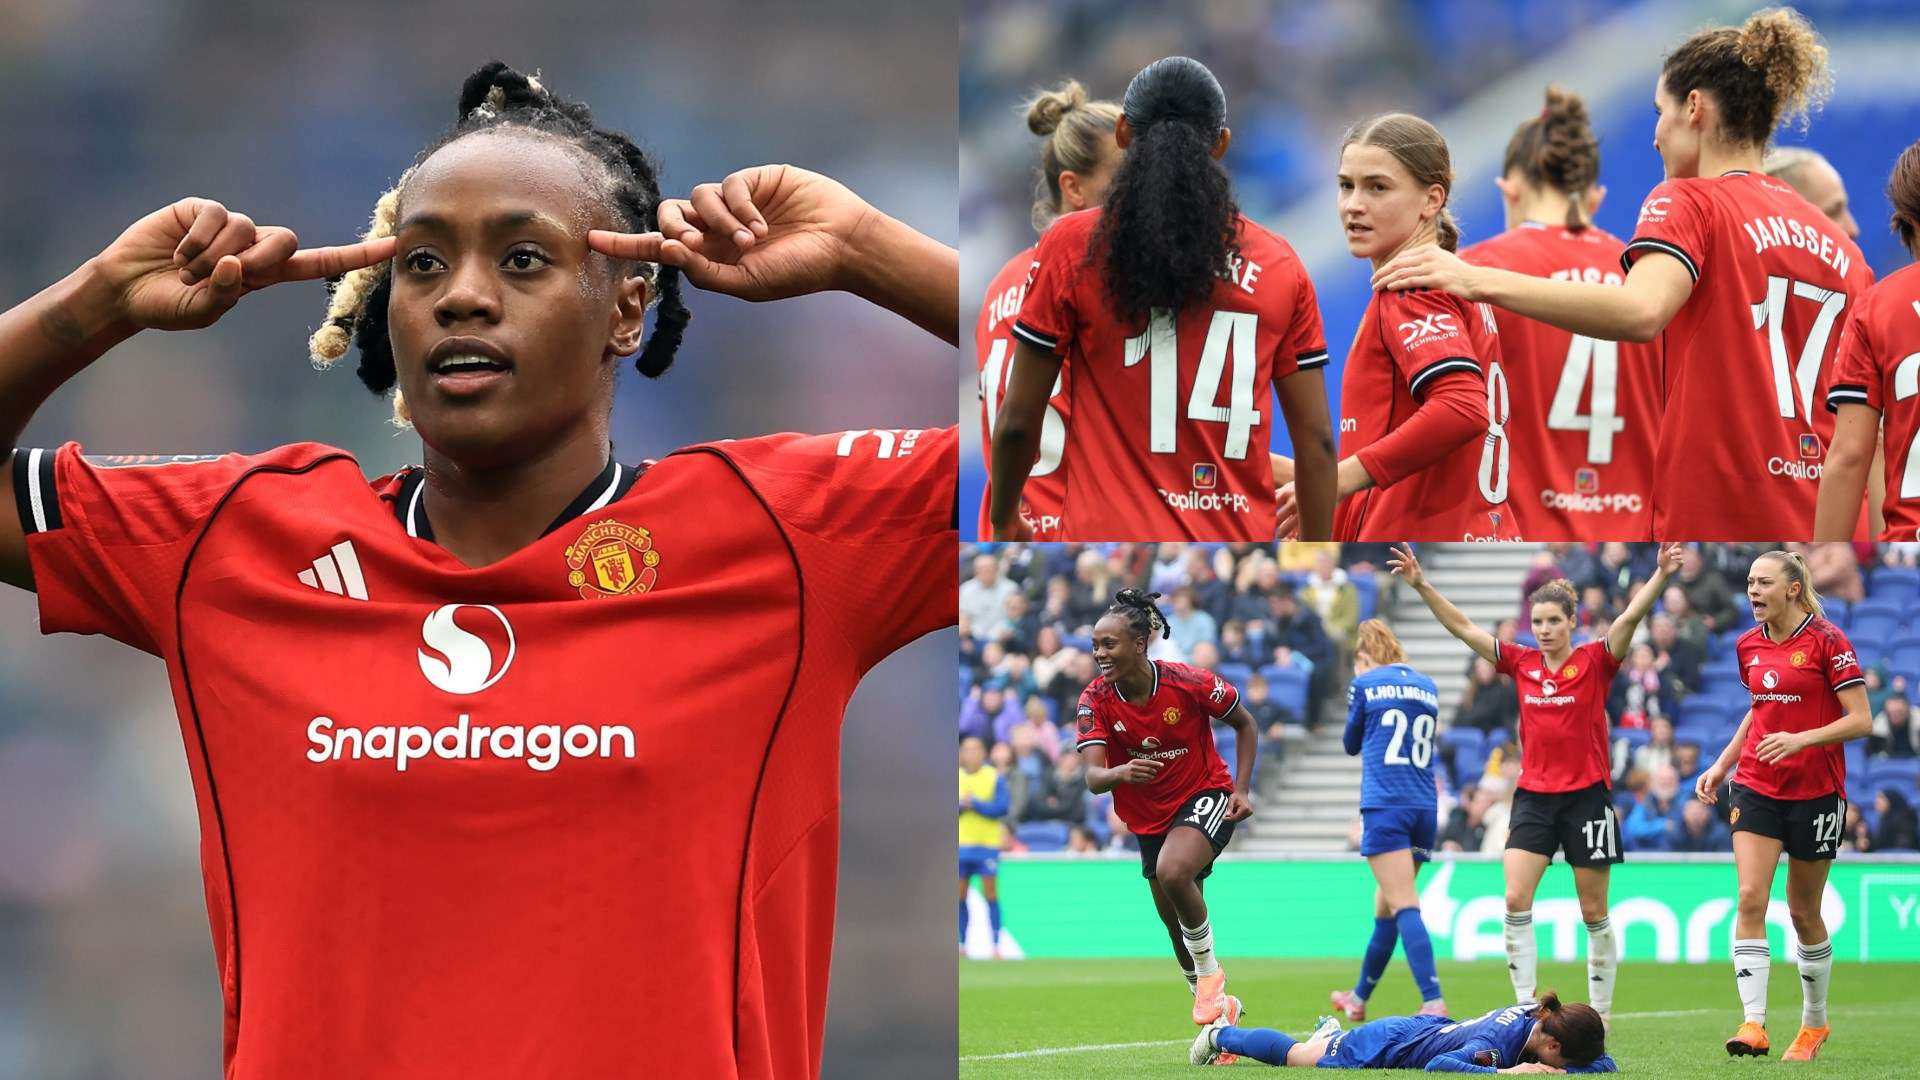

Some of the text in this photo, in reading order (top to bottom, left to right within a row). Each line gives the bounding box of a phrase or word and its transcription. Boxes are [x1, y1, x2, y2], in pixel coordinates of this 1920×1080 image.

[1744, 216, 1850, 280] JANSSEN
[1406, 331, 1460, 352] TECHNOLOGY
[1751, 275, 1847, 428] 17
[1124, 307, 1261, 460] 14
[1548, 333, 1625, 464] 4
[1478, 361, 1510, 504] 8
[573, 526, 645, 563] MANCHESTER
[1524, 694, 1575, 706] Snapdragon
[306, 714, 636, 772] Snapdragon
[1381, 708, 1436, 769] 28
[1192, 796, 1215, 816] 9
[1582, 819, 1607, 849] 17
[1813, 812, 1837, 842] 12
